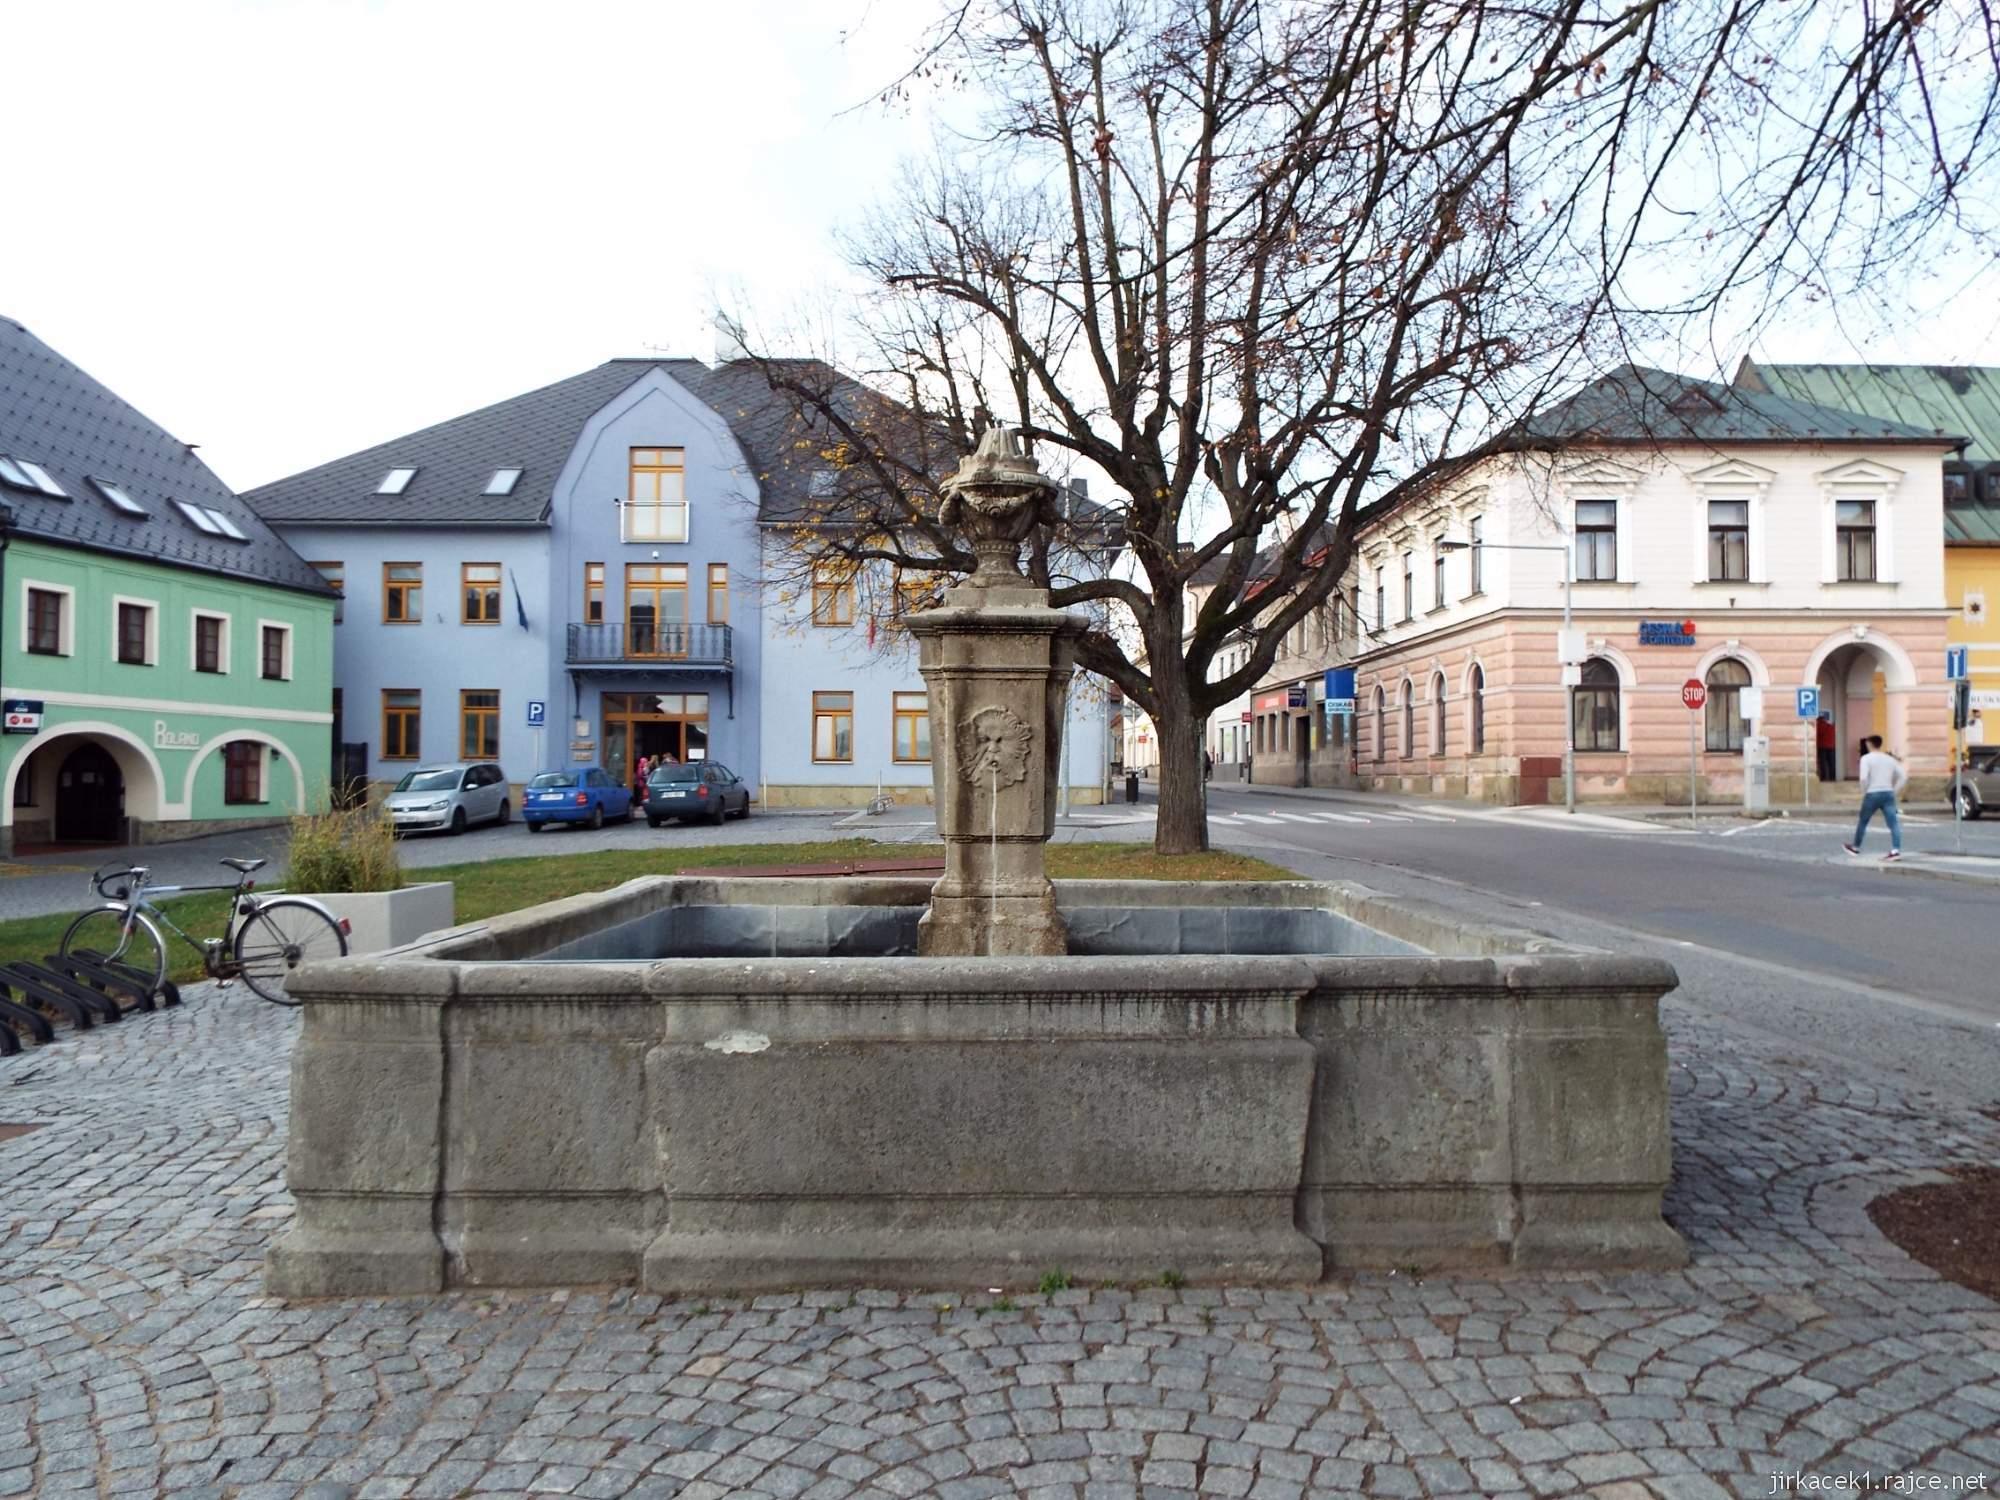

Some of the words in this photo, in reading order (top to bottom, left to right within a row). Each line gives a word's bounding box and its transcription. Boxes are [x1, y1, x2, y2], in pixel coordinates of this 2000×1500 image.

[1683, 688, 1704, 701] STOP
[1800, 691, 1814, 709] P
[529, 703, 543, 720] P
